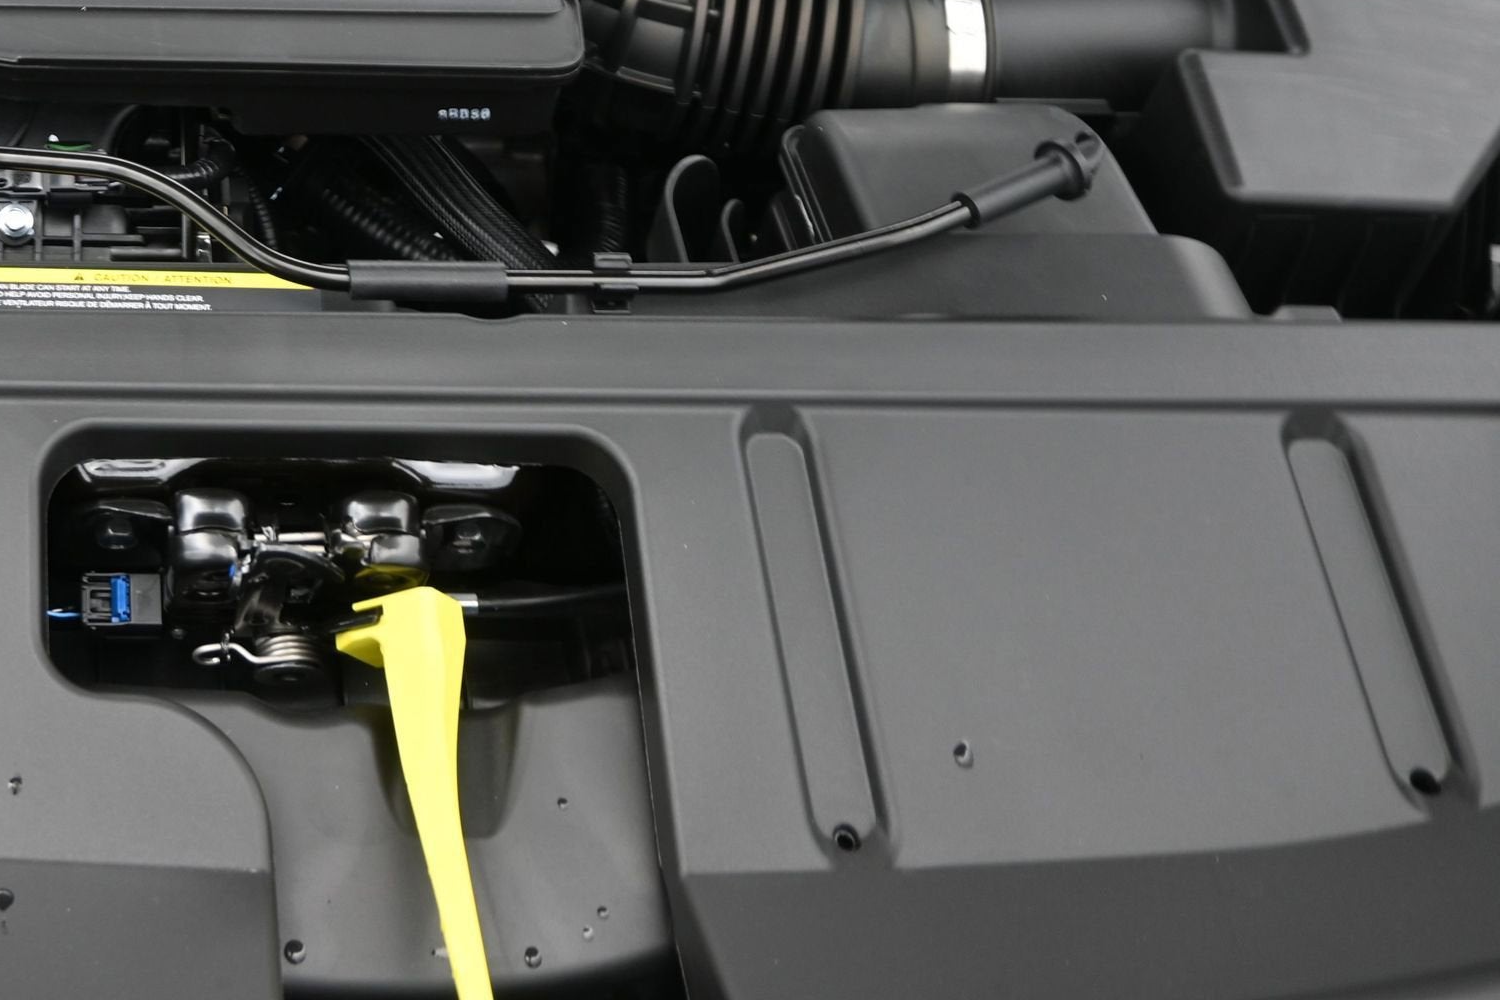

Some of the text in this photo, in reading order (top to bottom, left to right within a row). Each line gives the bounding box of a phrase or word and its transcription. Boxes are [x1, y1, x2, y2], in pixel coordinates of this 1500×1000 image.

[94, 273, 149, 282] CAUTION
[164, 275, 232, 284] ATTENTION
[3, 299, 54, 307] VENTILATEUR
[152, 302, 174, 310] TOUT
